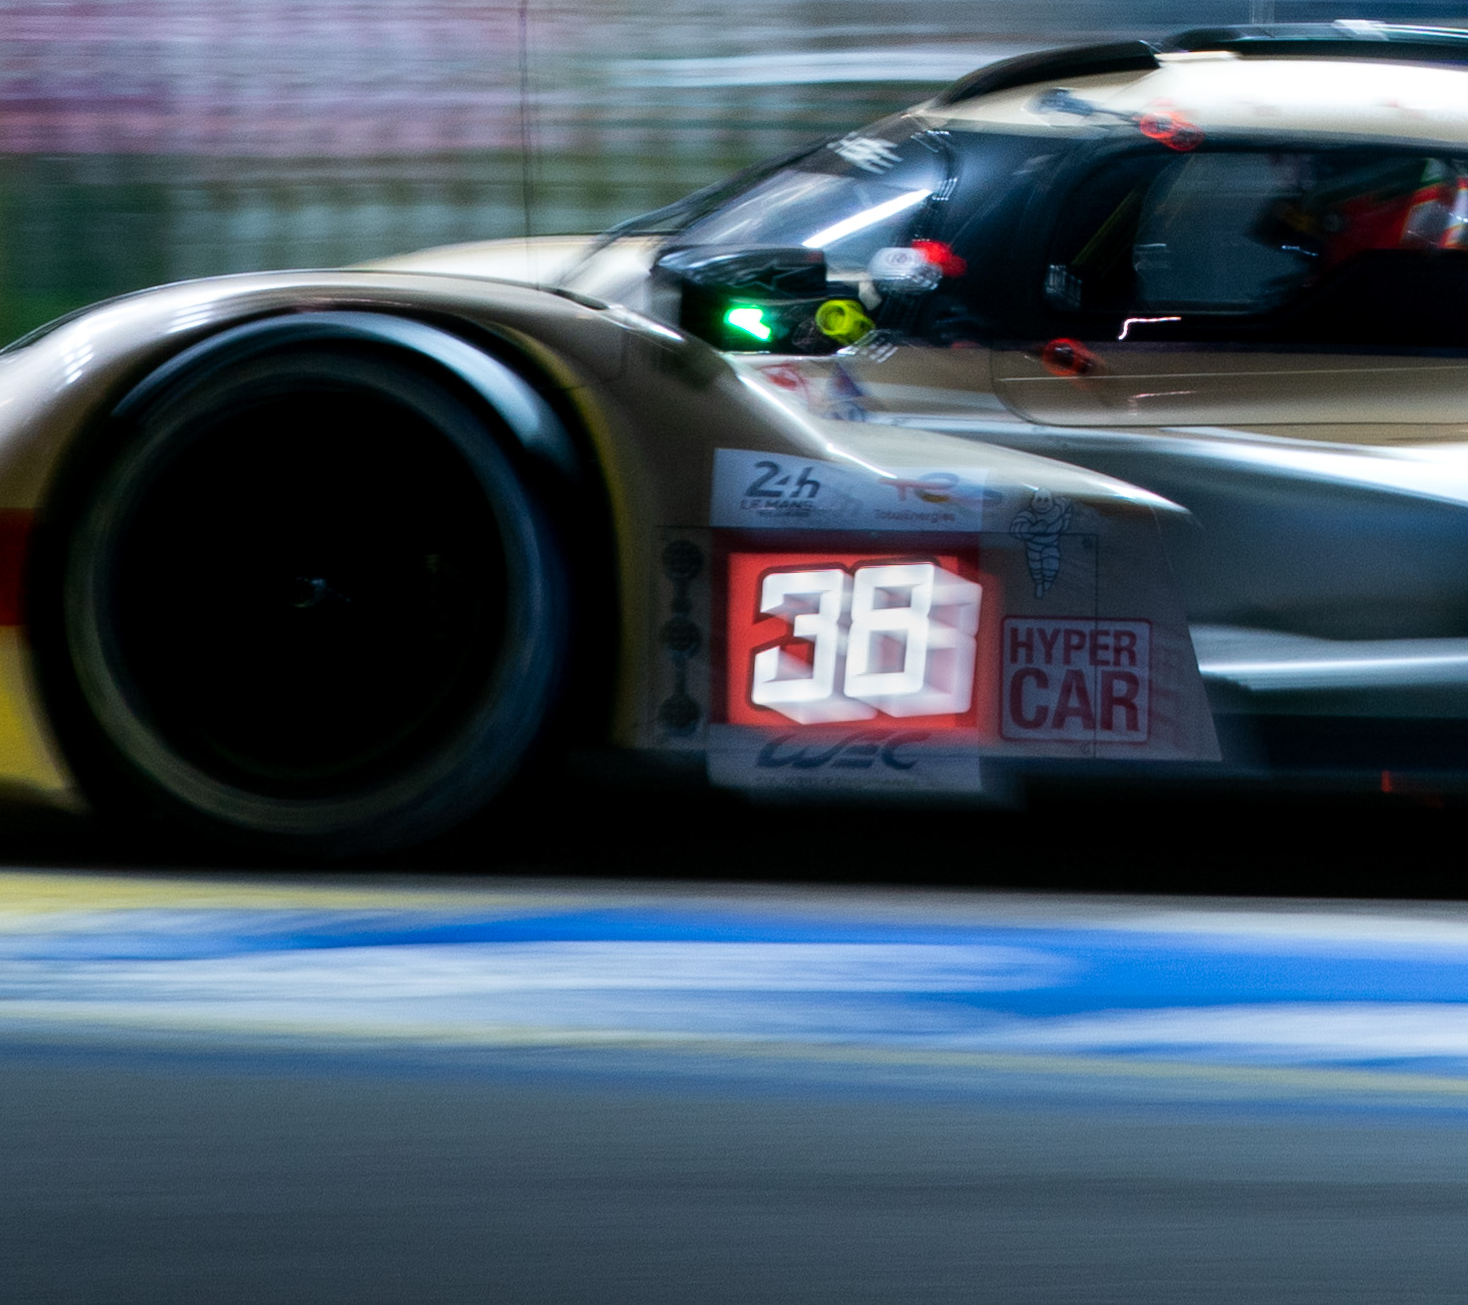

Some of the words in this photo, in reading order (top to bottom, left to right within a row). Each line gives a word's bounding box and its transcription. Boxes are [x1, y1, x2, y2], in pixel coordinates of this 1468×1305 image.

[752, 561, 968, 717] 38
[1009, 628, 1138, 668] HYPER
[1008, 666, 1141, 733] CAR
